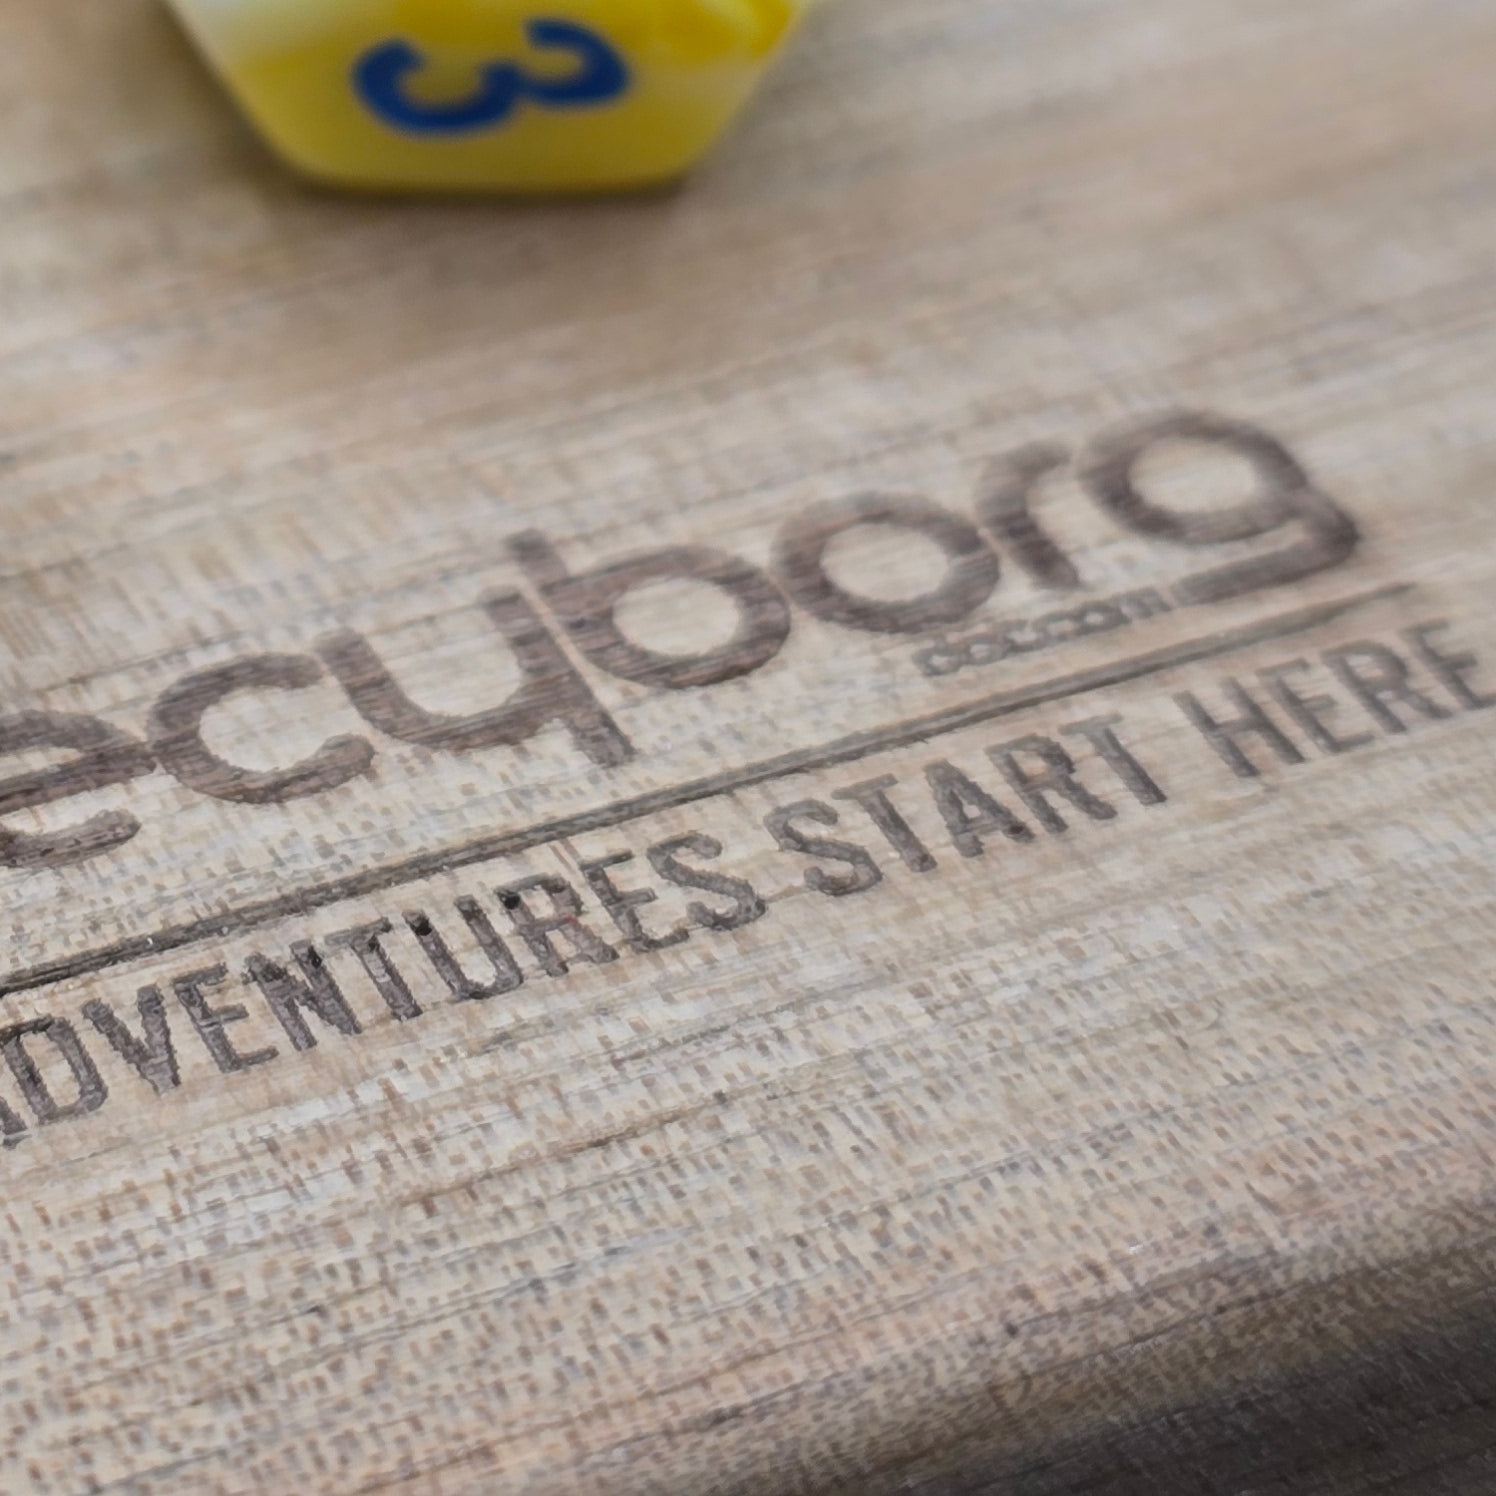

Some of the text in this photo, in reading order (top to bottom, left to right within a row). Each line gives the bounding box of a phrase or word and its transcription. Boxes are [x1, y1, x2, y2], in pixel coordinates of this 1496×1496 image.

[350, 18, 632, 138] 3
[762, 712, 1168, 898] START
[1220, 618, 1496, 778] HERE
